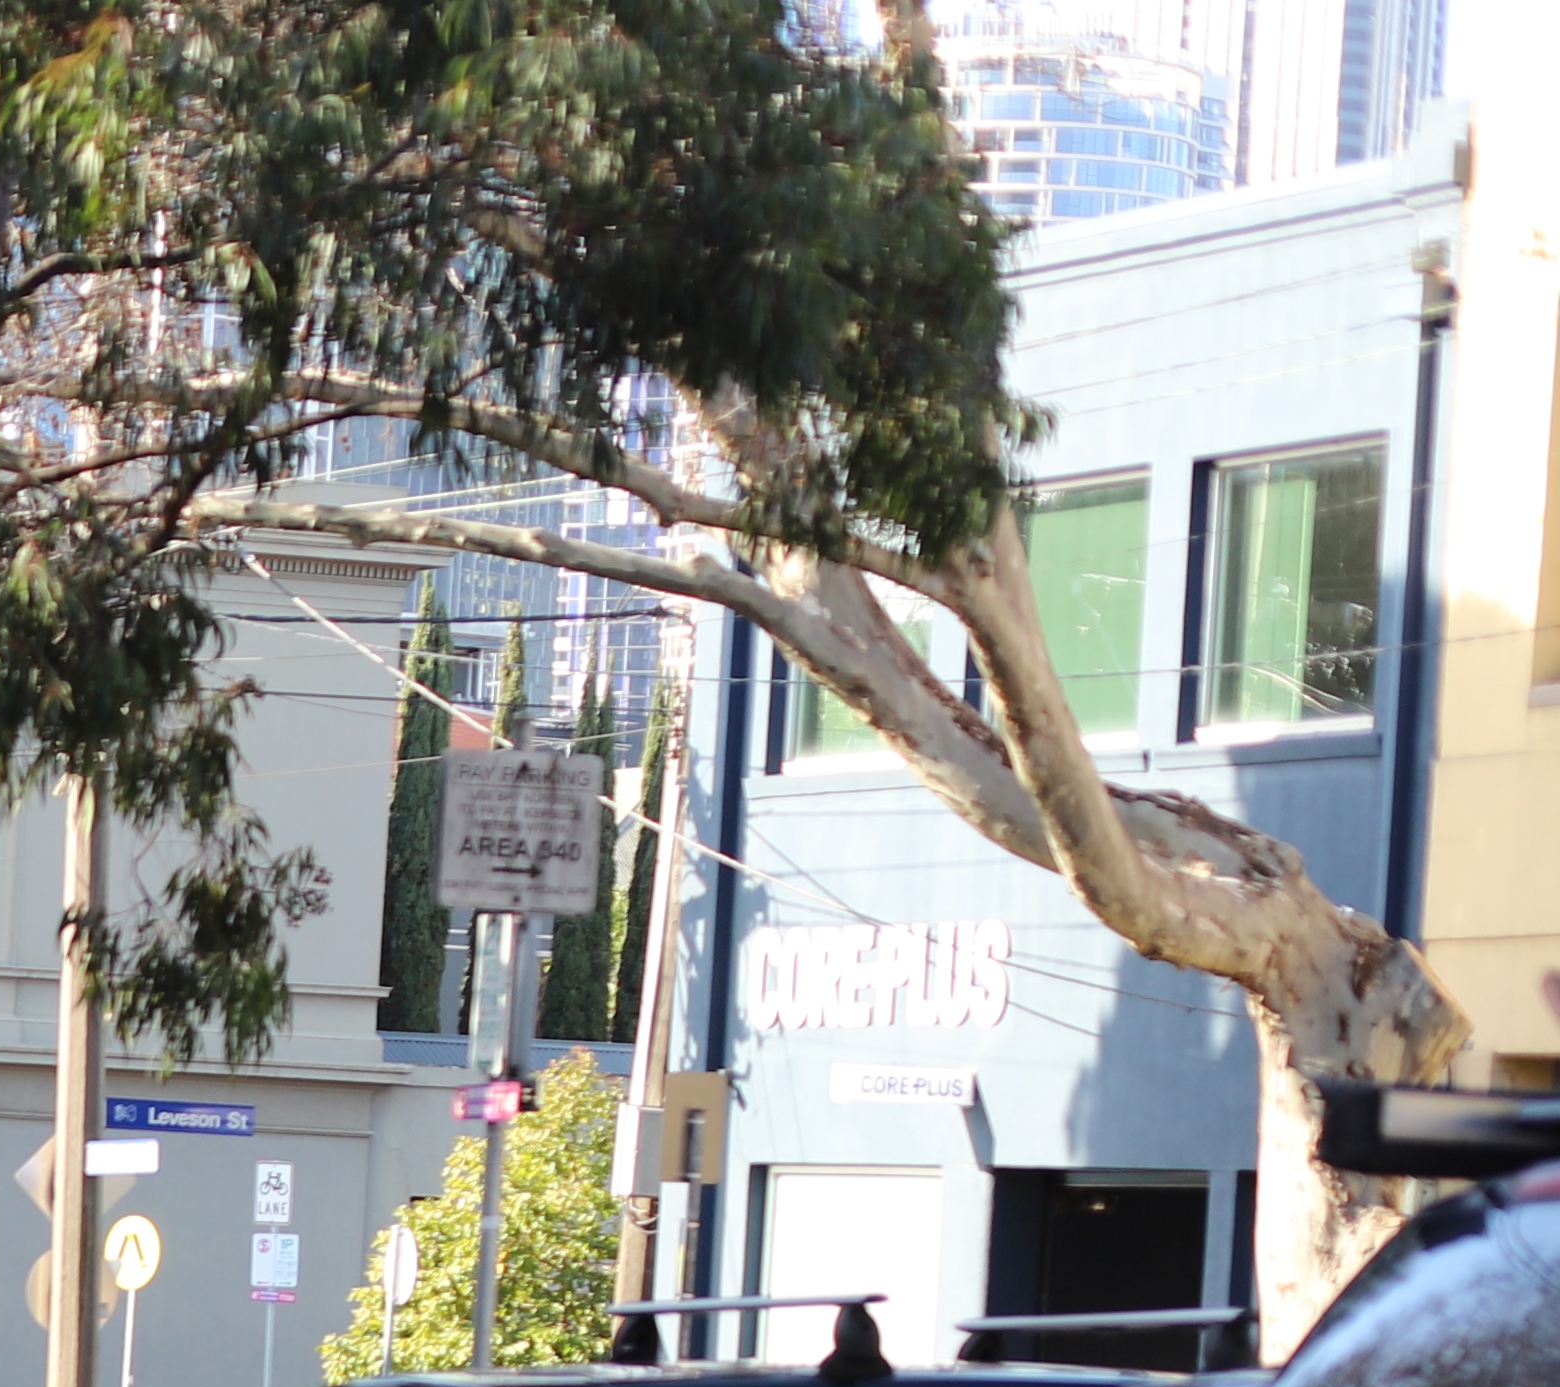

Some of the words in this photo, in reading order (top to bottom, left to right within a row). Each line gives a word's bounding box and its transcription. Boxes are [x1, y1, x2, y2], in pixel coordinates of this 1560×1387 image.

[459, 763, 496, 780] PAY
[458, 836, 531, 858] AREA
[147, 1106, 221, 1128] Leveson
[226, 1110, 249, 1131] St
[258, 1201, 288, 1216] LANE
